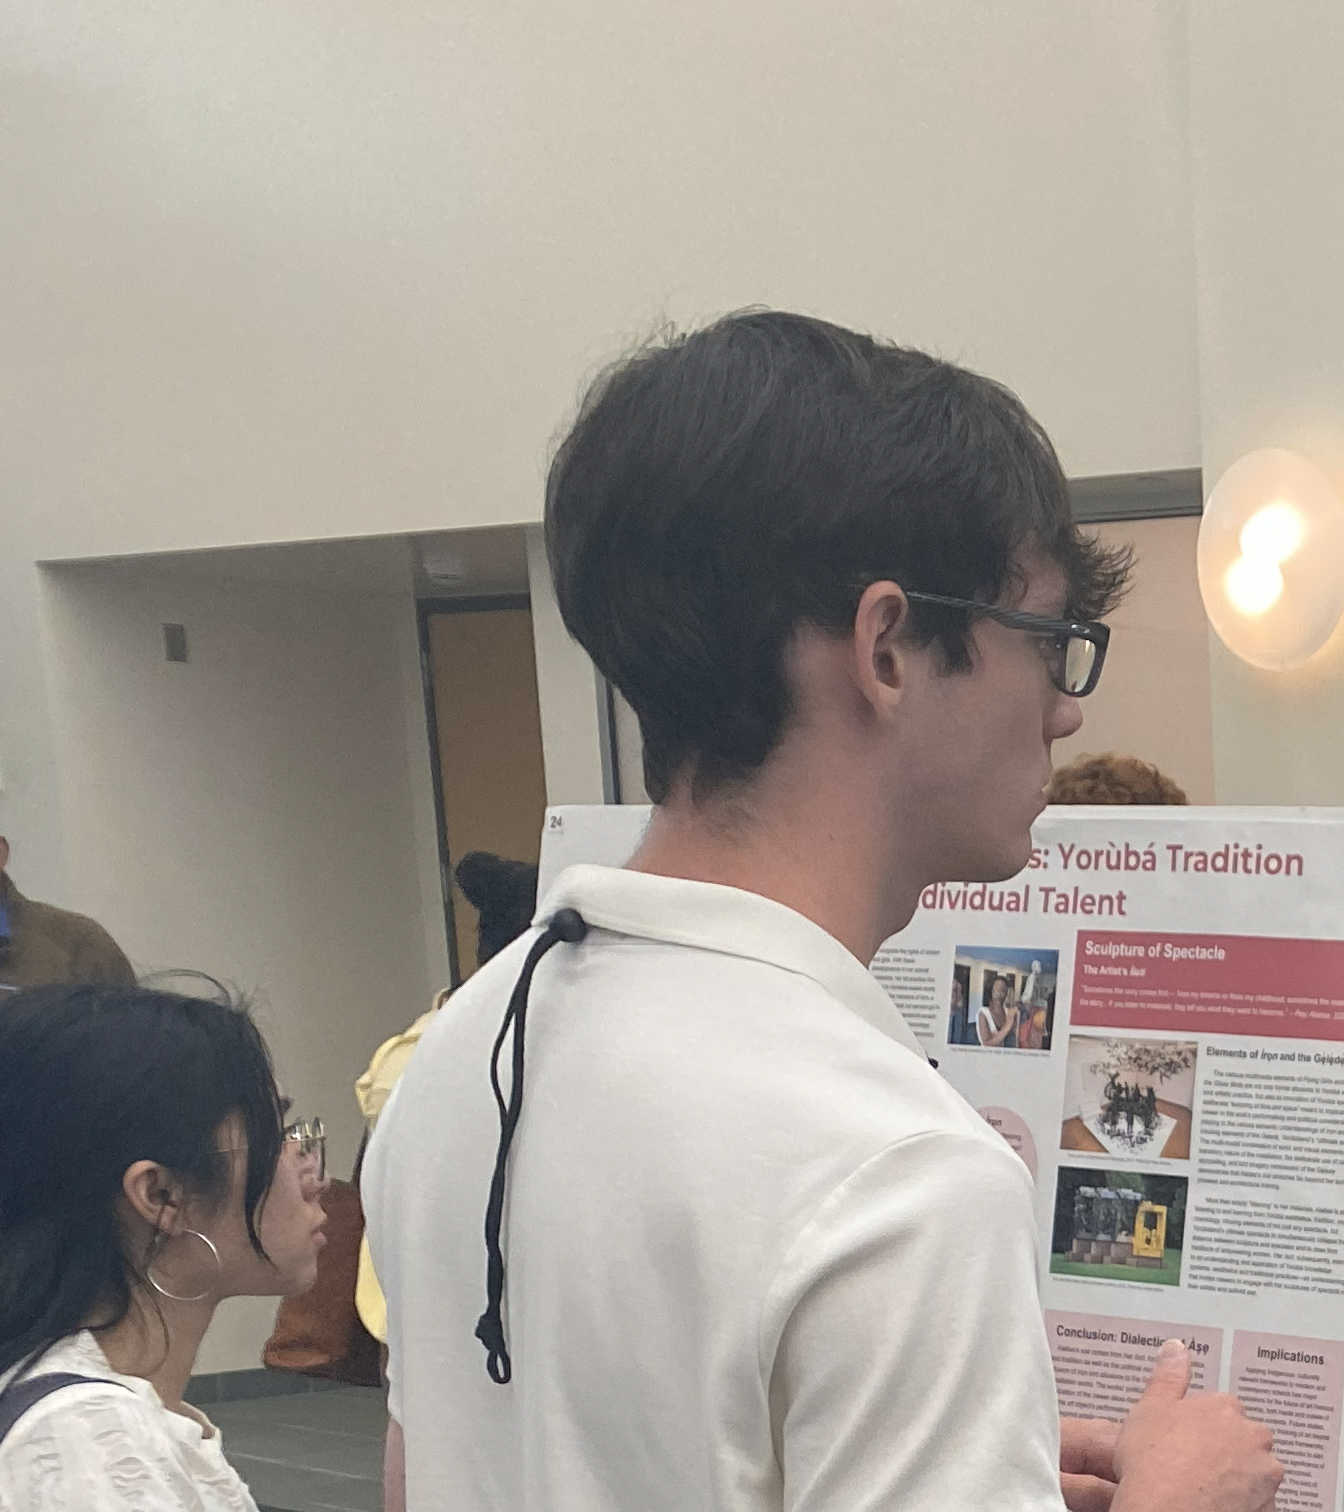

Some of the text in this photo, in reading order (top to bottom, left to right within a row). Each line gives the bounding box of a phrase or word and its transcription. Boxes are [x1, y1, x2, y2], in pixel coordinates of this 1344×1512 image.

[551, 816, 562, 828] 24
[1057, 841, 1156, 871] Yorùbá
[1166, 843, 1304, 877] Tradition
[918, 884, 1127, 916] dividual Talent
[1085, 940, 1225, 961] Sculpture of Spectacle
[1207, 1047, 1311, 1062] Elements of and the
[1056, 1325, 1164, 1348] Conclusion: Dialectic
[1257, 1346, 1324, 1366] Implications
